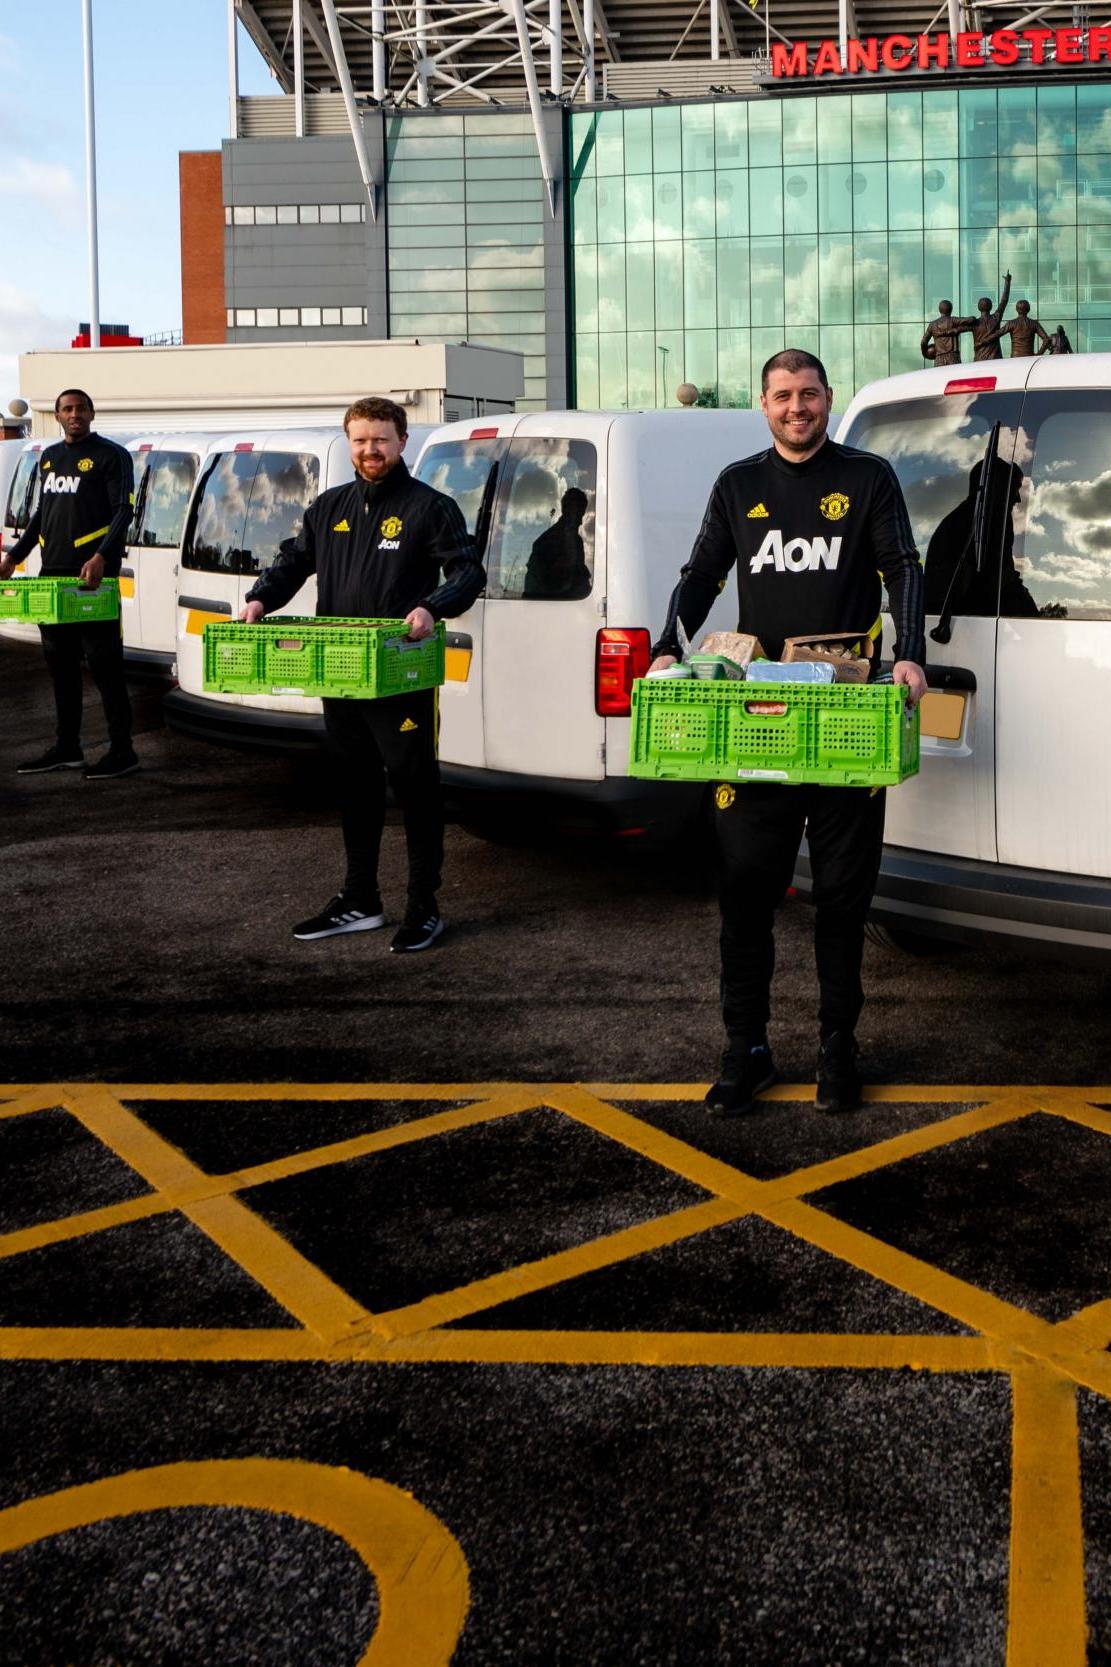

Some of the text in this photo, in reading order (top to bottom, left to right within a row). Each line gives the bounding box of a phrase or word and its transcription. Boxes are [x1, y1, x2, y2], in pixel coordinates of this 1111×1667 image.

[44, 472, 80, 493] AON
[378, 539, 400, 549] AON
[750, 530, 842, 574] AON
